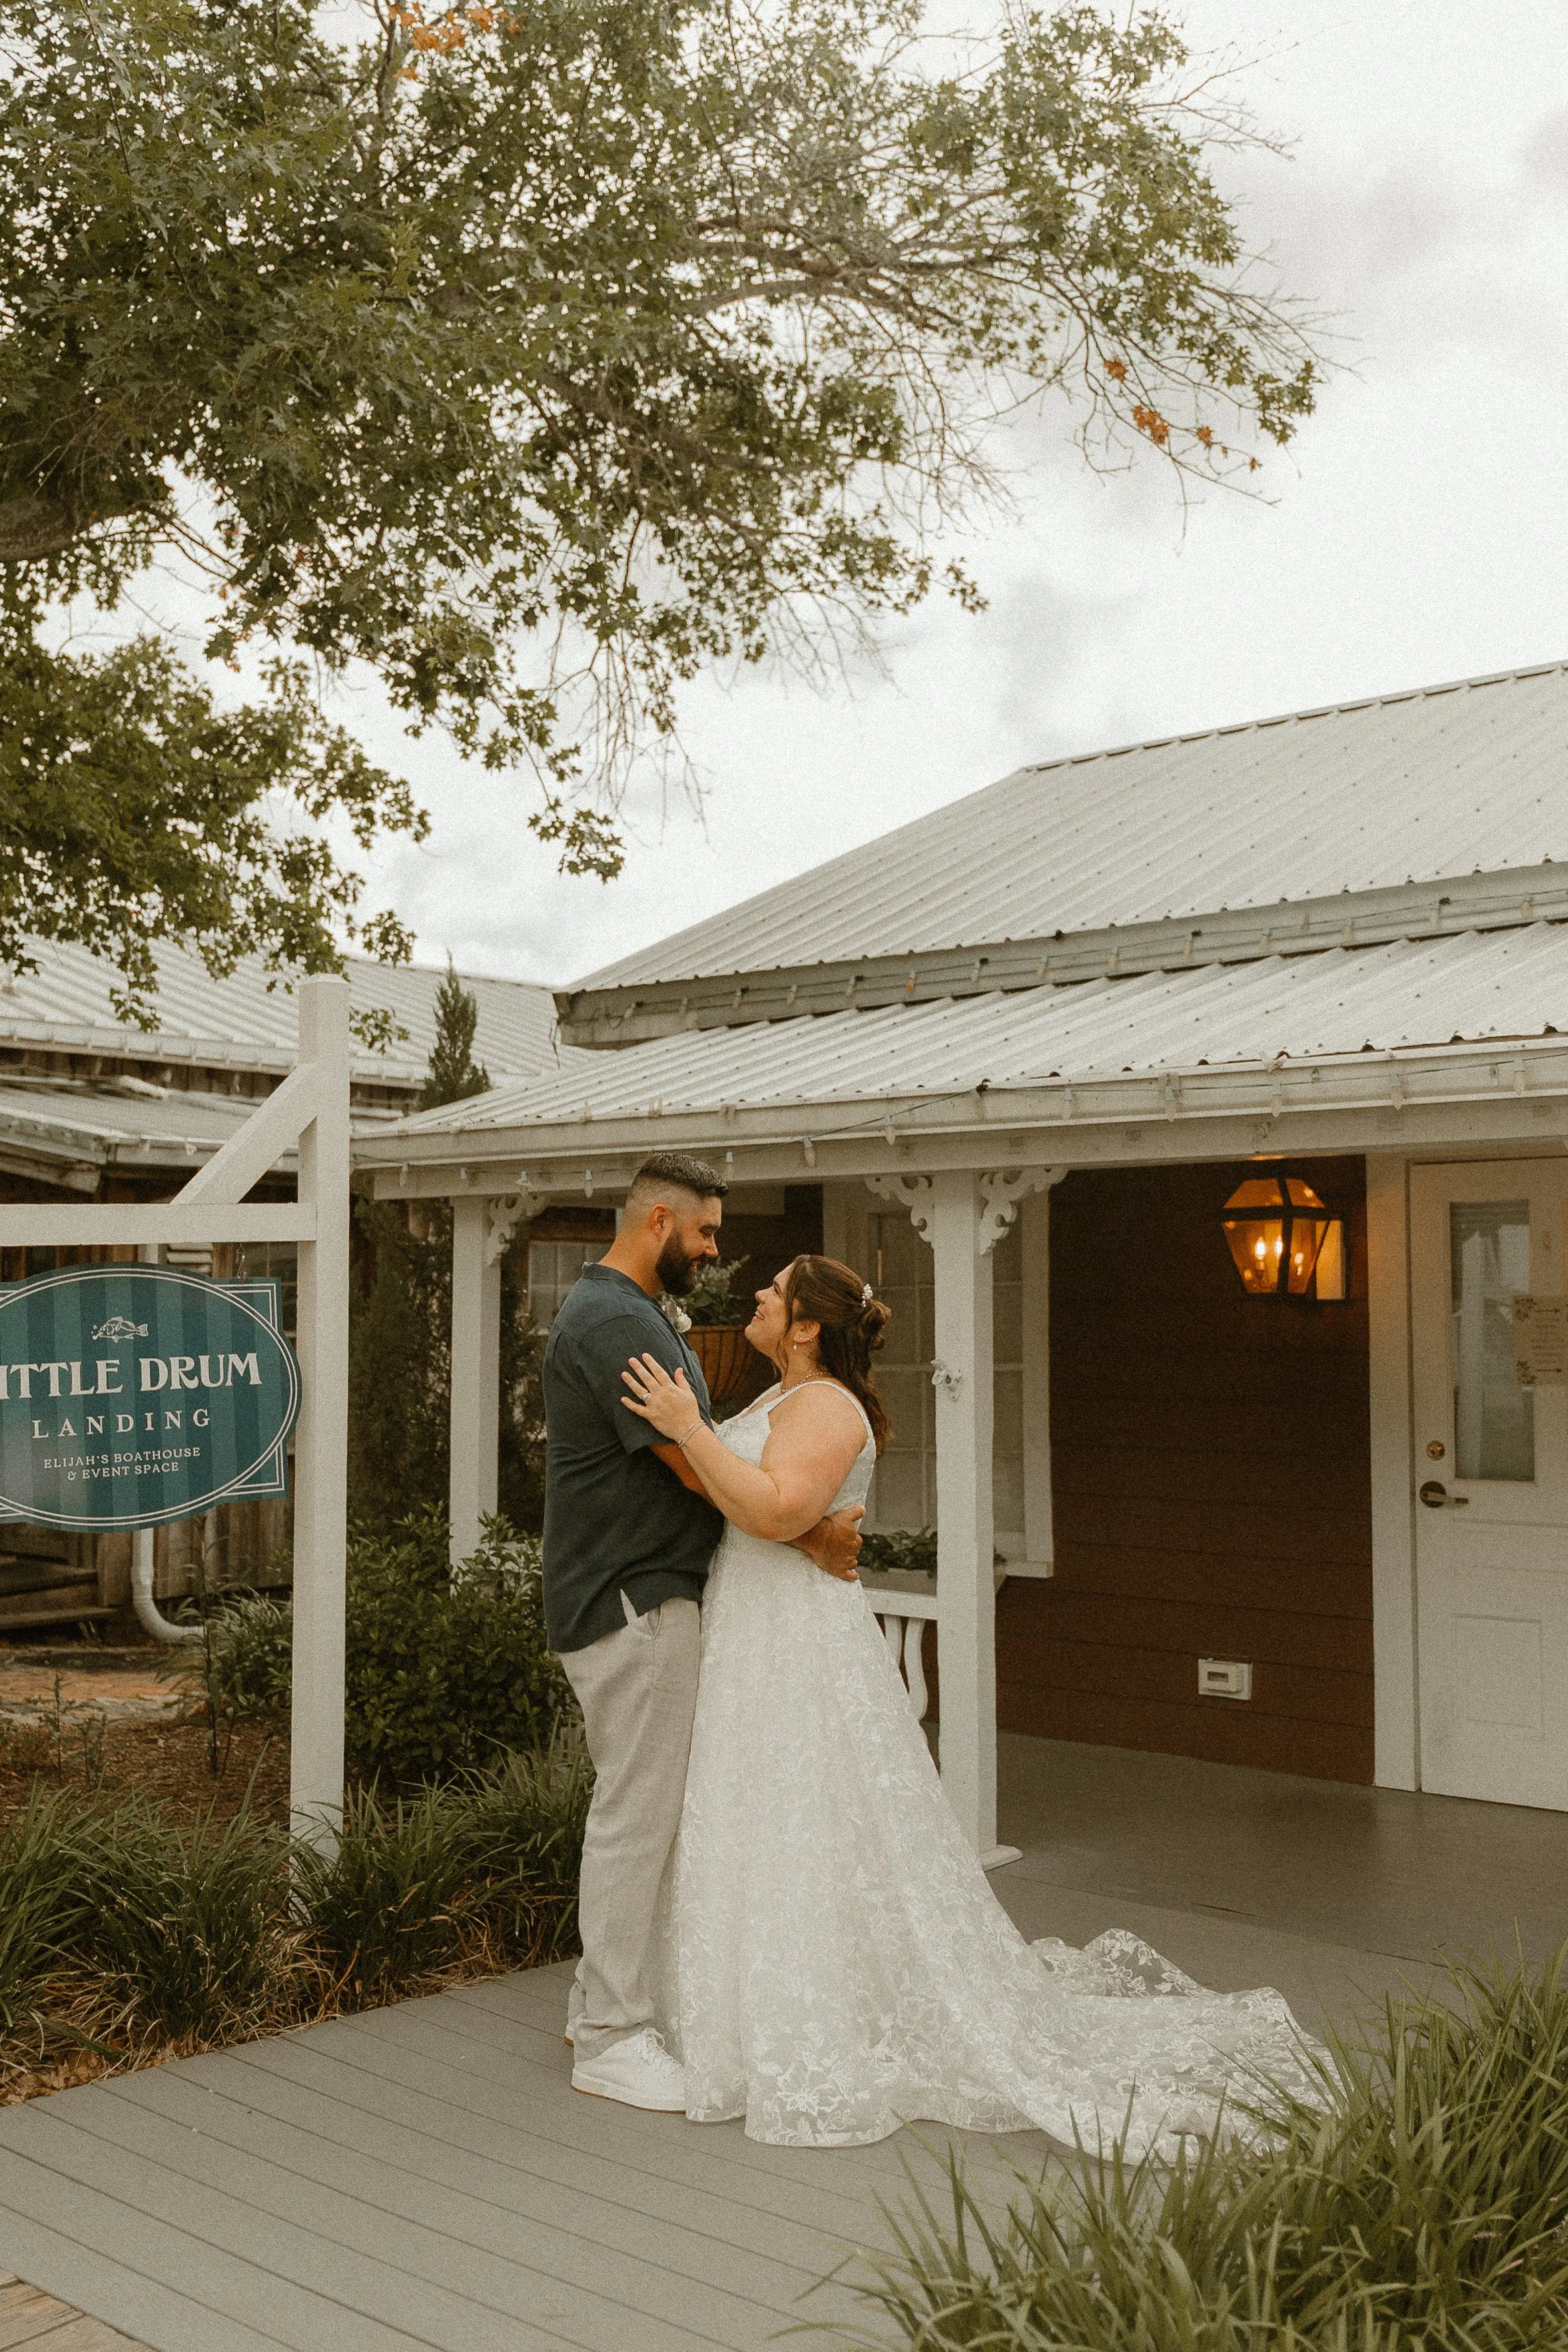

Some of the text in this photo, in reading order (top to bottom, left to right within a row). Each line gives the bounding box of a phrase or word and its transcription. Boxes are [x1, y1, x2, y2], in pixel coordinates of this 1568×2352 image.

[139, 1353, 262, 1391] DRUM
[33, 1409, 210, 1439] LANDING
[44, 1447, 200, 1469] ELIJAH'S BOATHOUSE
[67, 1462, 179, 1480] & EVENT SPACE
